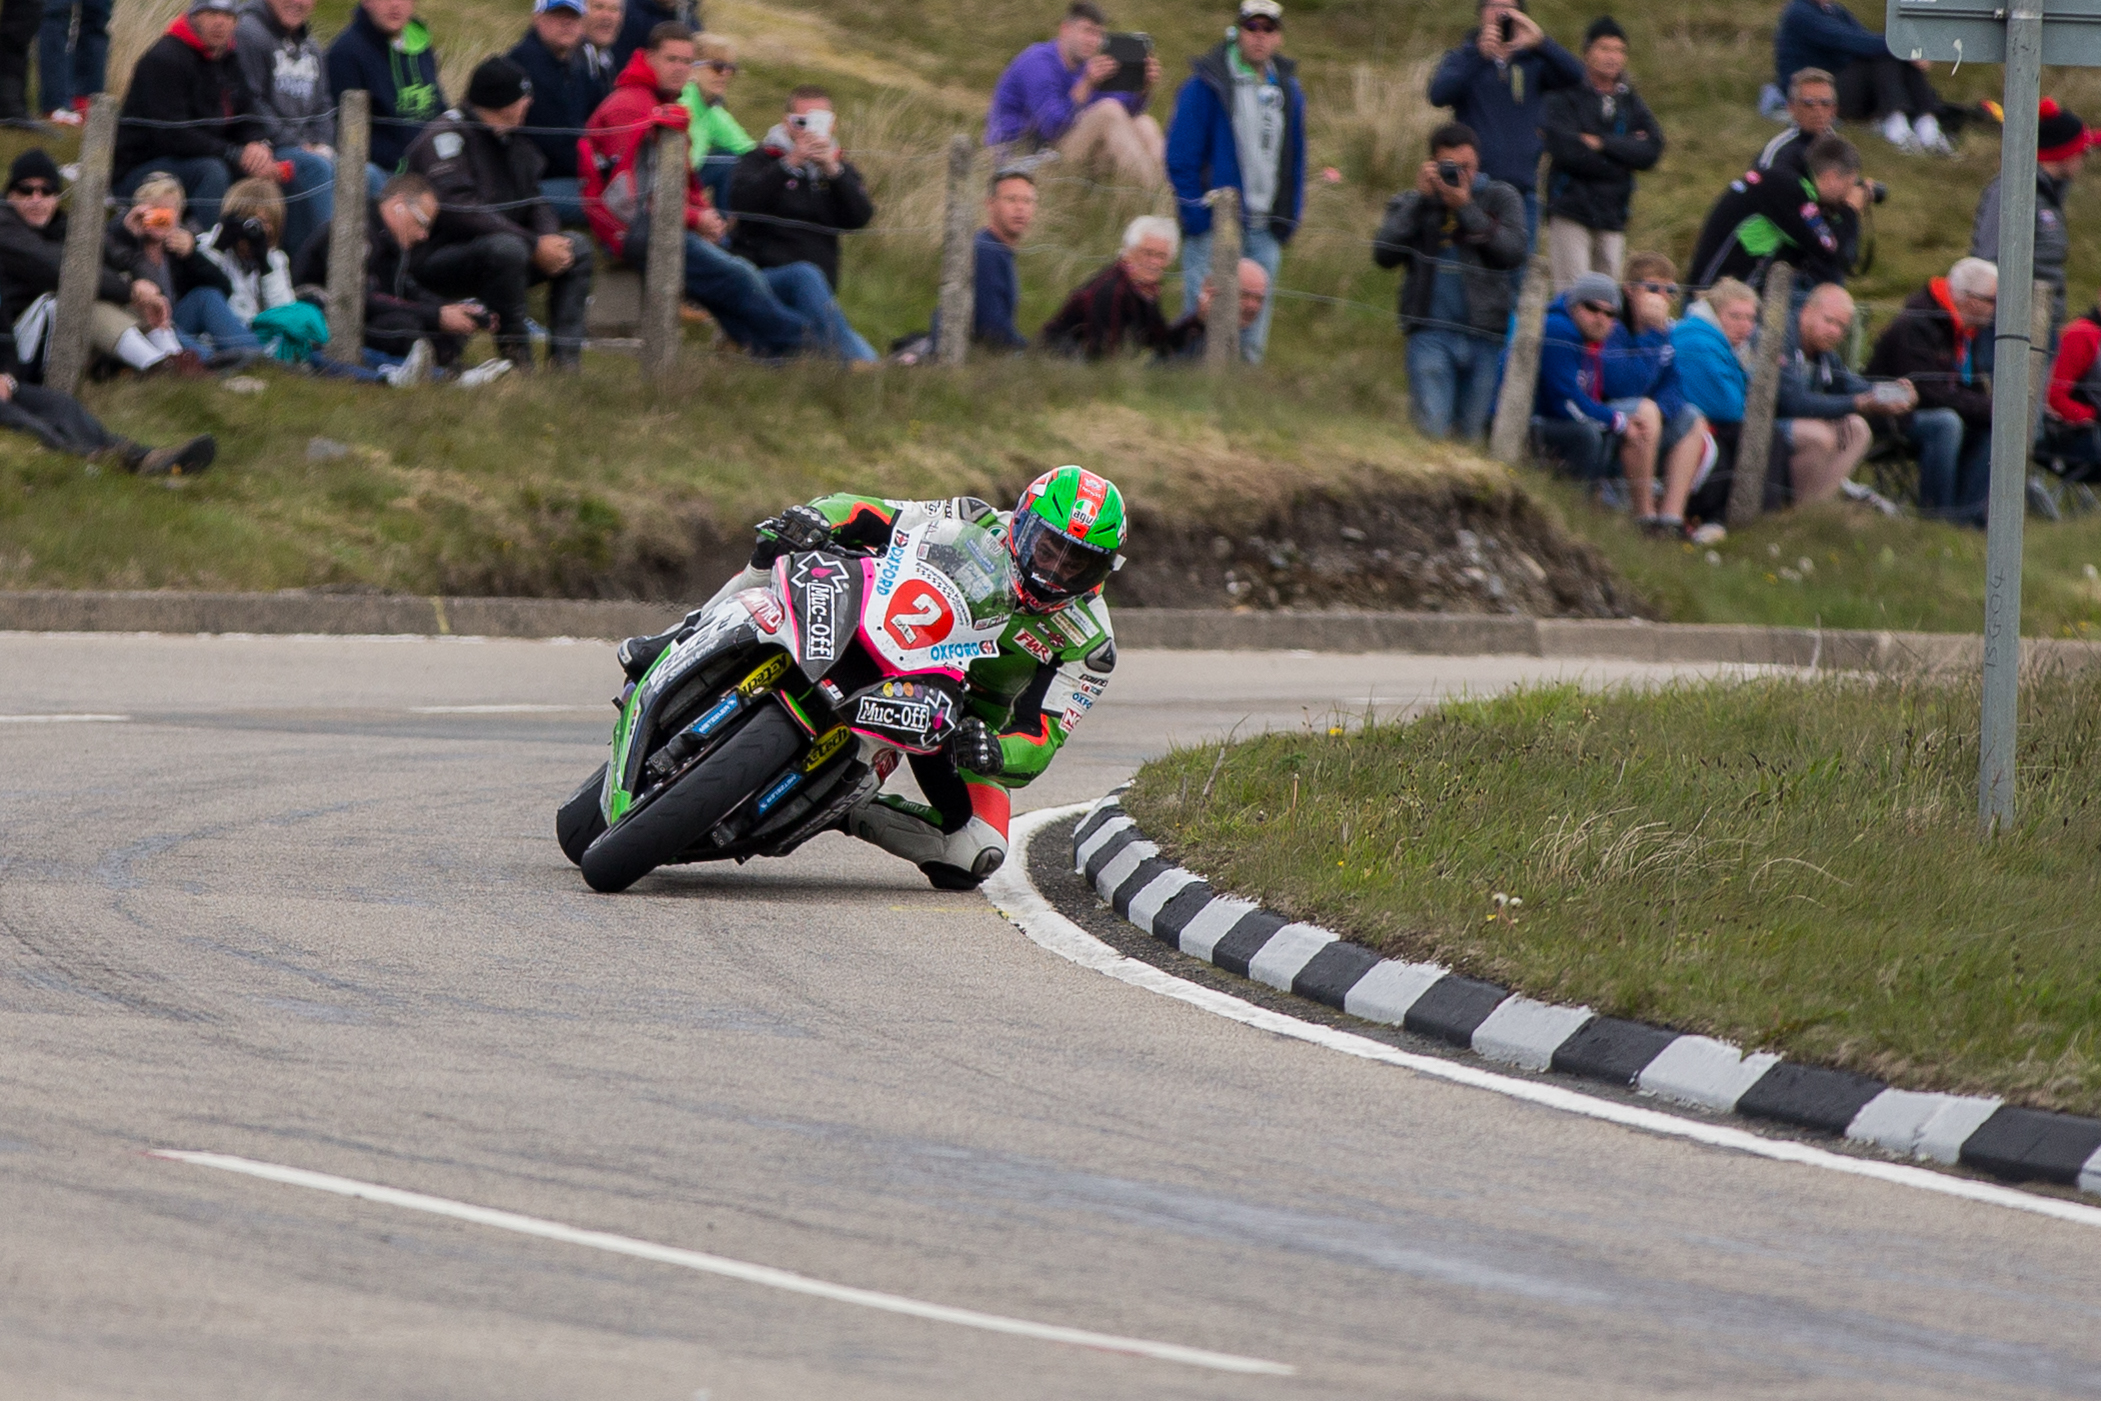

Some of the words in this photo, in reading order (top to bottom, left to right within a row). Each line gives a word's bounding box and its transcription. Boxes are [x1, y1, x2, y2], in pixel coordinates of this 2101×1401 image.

[1072, 509, 1095, 526] agv
[876, 546, 905, 596] OXFORD
[810, 583, 832, 658] Muc-Off
[890, 593, 942, 644] 2
[930, 642, 980, 661] OXFORD
[1015, 630, 1049, 662] FWR
[862, 702, 928, 729] Muc-Off
